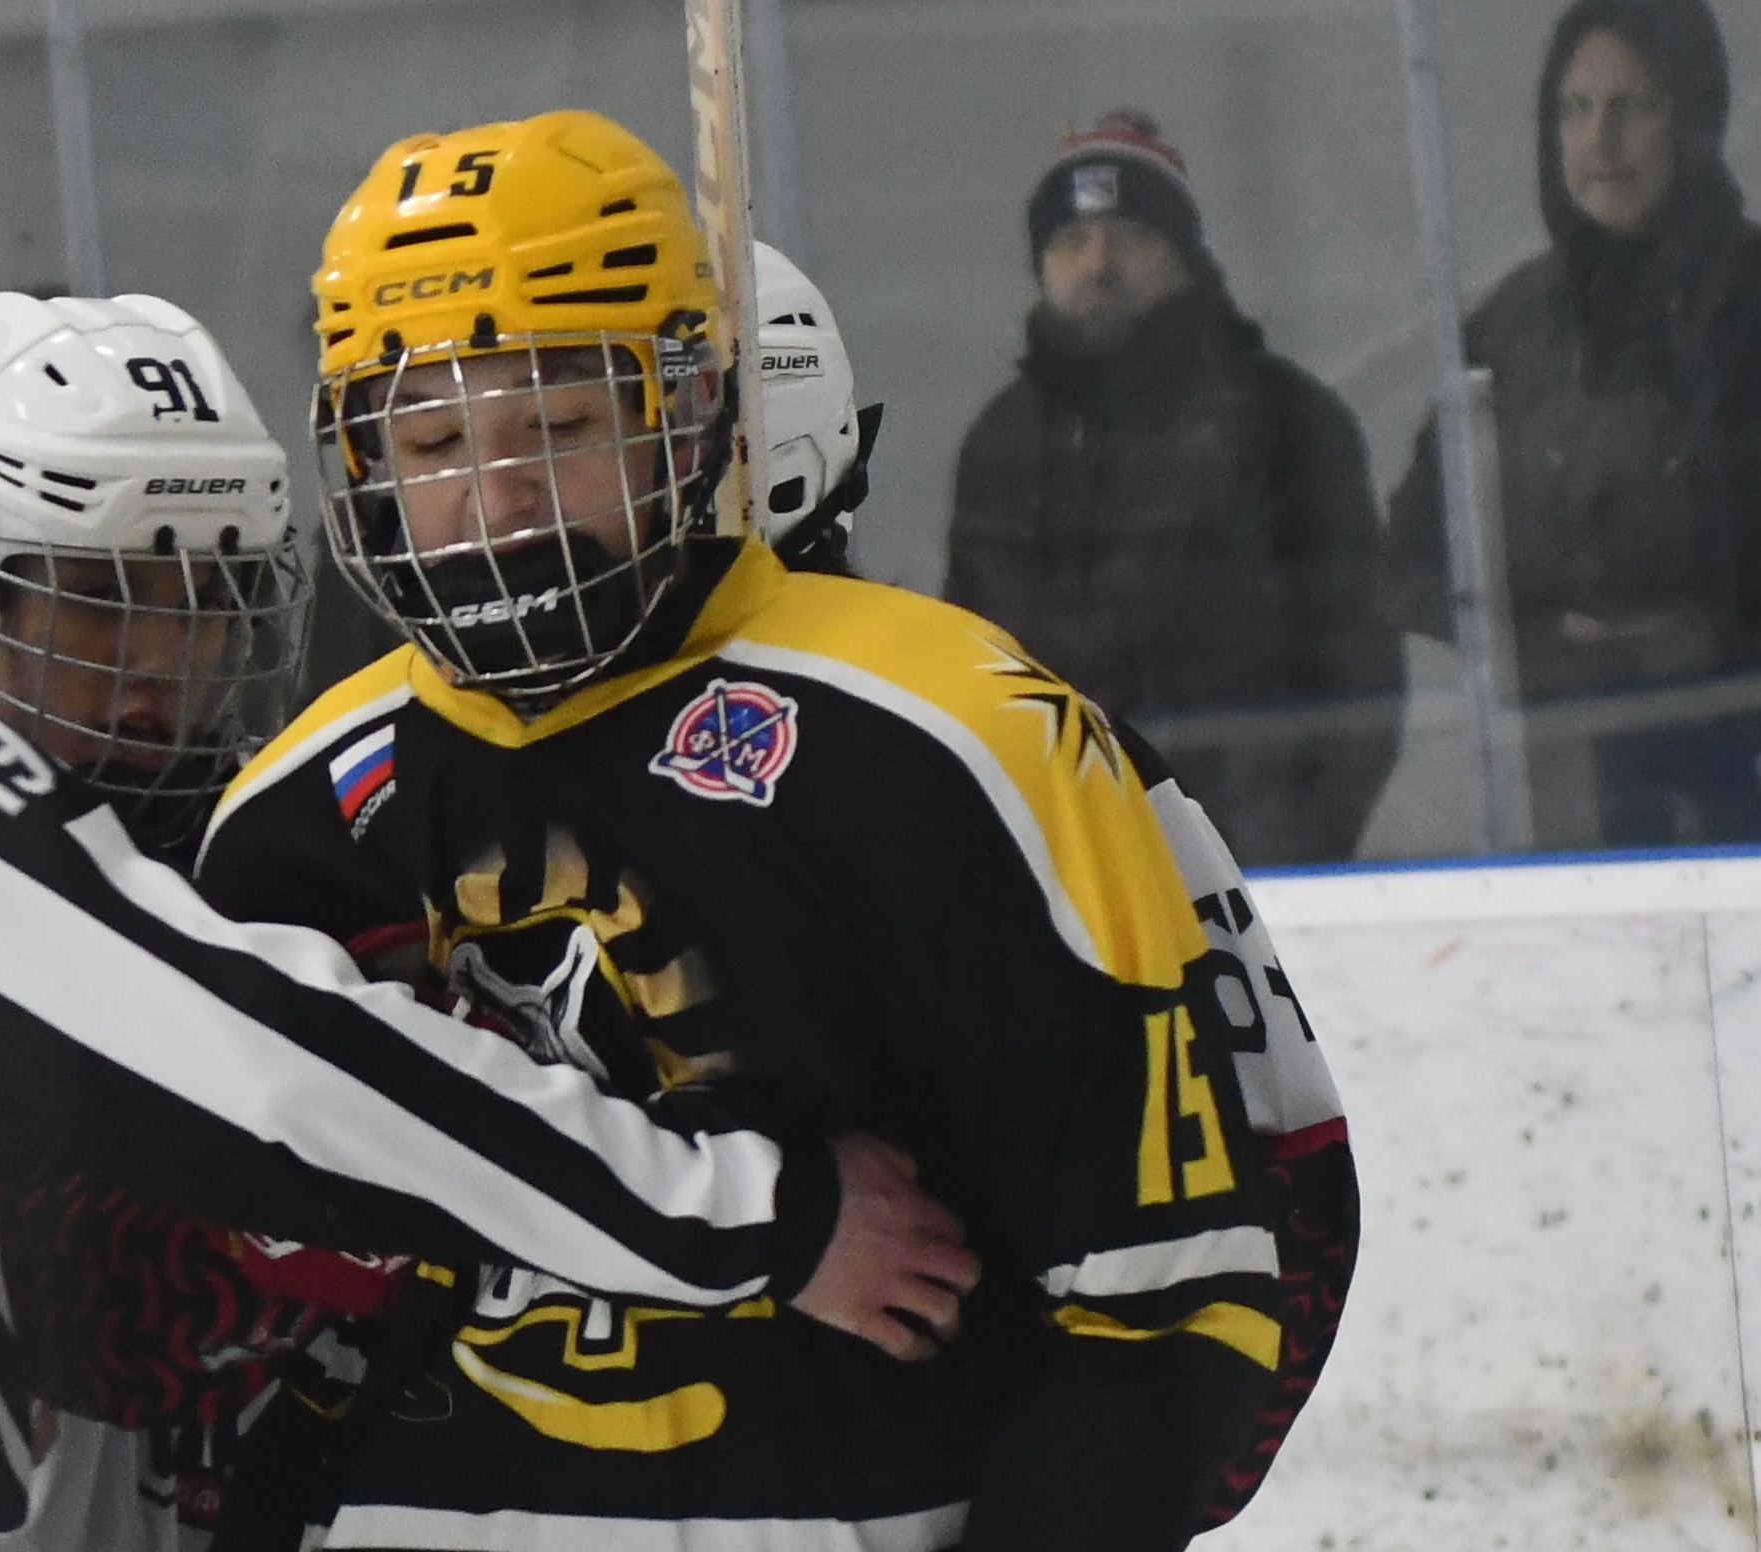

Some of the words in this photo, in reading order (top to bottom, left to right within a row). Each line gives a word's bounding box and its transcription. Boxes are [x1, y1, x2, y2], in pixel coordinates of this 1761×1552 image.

[397, 150, 501, 203] 15
[374, 267, 495, 307] CCM
[662, 364, 700, 377] CCM
[760, 354, 819, 371] AUER
[126, 357, 221, 422] 91
[145, 477, 247, 495] BAUER
[451, 587, 559, 628] CCM
[1137, 1004, 1236, 1207] 15
